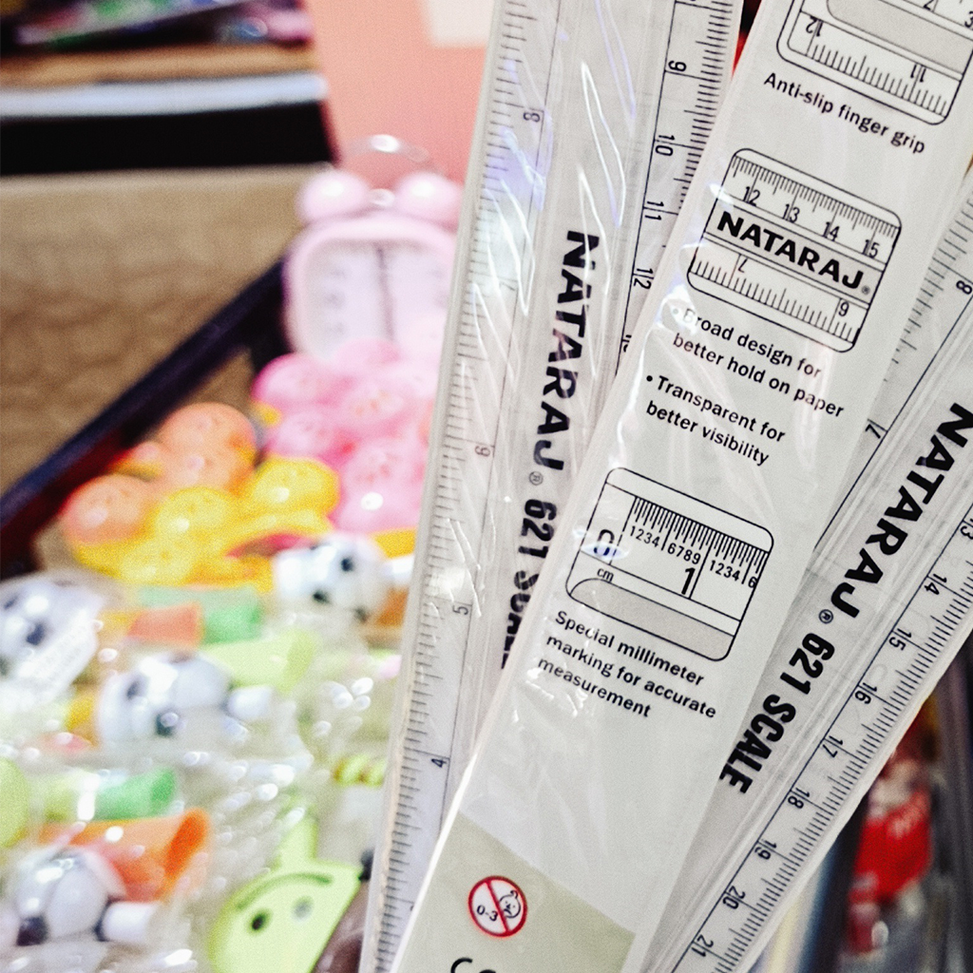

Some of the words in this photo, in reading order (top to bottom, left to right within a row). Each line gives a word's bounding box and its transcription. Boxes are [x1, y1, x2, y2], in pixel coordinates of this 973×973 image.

[668, 61, 687, 72] 9
[523, 111, 541, 123] 8
[764, 72, 834, 114] Anti-slip
[838, 103, 889, 136] finger
[890, 124, 925, 154] grip
[655, 134, 675, 157] 10
[644, 200, 664, 221] 11
[742, 186, 760, 207] 12
[782, 203, 801, 224] 13
[822, 221, 840, 242] 14
[862, 239, 880, 259] 15
[717, 211, 864, 289] NATARAJ
[633, 268, 654, 289] 12
[956, 280, 973, 295] 8
[737, 334, 793, 366] design
[797, 358, 821, 378] for
[672, 333, 724, 365] better
[727, 356, 766, 383] hold
[768, 377, 791, 394] on
[793, 388, 844, 417] paper
[656, 375, 757, 432] Transparent
[760, 421, 786, 442] for
[646, 400, 698, 433] better
[702, 426, 770, 467] visibility
[865, 423, 881, 439] 7
[518, 499, 557, 558] 621
[597, 566, 614, 582] cm
[681, 567, 697, 595] 1
[924, 573, 947, 595] 14
[453, 605, 469, 616] 5
[555, 610, 615, 648] Special
[617, 641, 704, 686] millimeter
[888, 627, 912, 651] 15
[780, 632, 835, 695] 621
[538, 657, 652, 718] measurement
[546, 635, 615, 678] marking
[616, 666, 641, 687] for
[643, 679, 717, 719] accurate
[854, 681, 878, 705] 16
[719, 694, 796, 794] SCALE
[822, 734, 843, 758] 17
[431, 757, 447, 768] 4
[787, 787, 810, 809] 18
[754, 839, 777, 860] 19
[722, 885, 745, 909] 20
[476, 904, 498, 923] 0-3
[691, 934, 714, 958] 21
